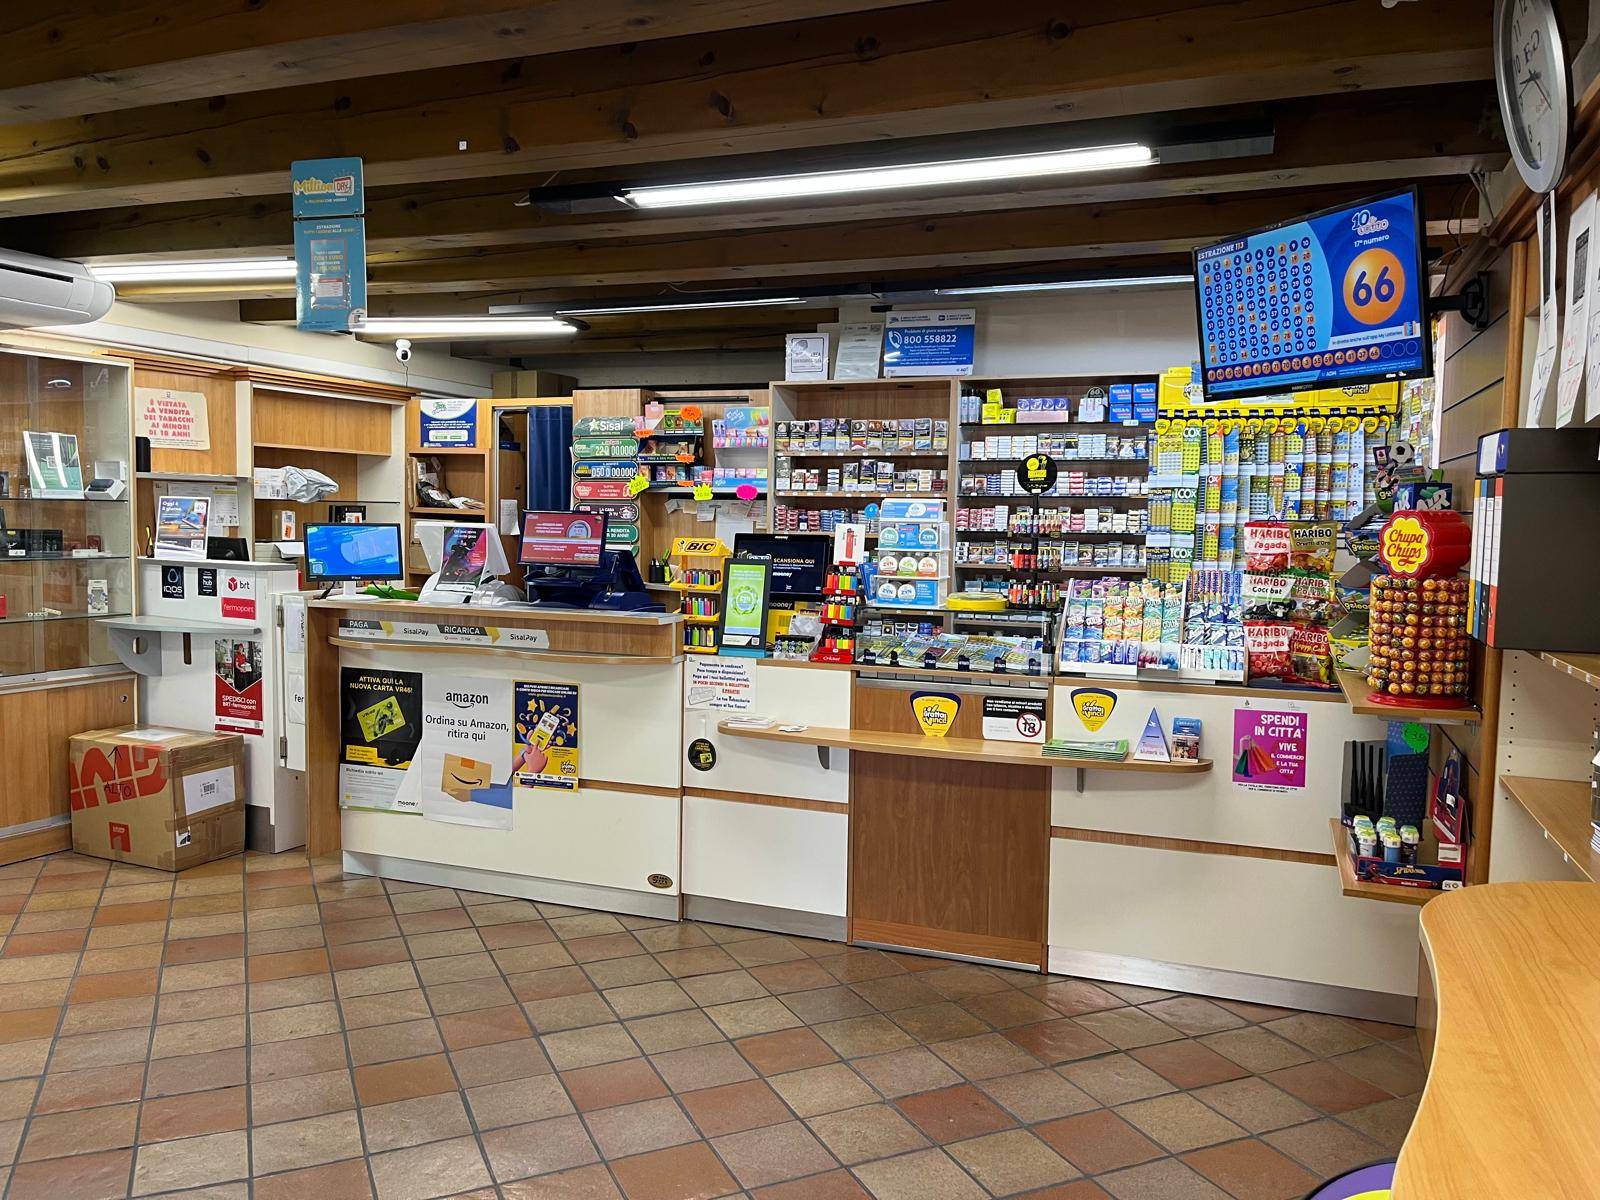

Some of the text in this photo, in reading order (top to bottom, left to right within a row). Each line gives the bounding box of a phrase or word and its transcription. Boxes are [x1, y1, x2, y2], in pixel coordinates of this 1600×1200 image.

[1364, 235, 1389, 245] numero
[1198, 242, 1244, 260] ESTRAZIONE 113
[1353, 266, 1395, 306] 66
[924, 335, 957, 343] 558822
[159, 415, 194, 423] TABACCHI
[600, 421, 624, 431] Sisal
[1294, 528, 1332, 539] HARIBO
[1390, 529, 1424, 546] Chupa
[687, 542, 715, 550] BIC
[1387, 543, 1422, 560] Chups
[240, 580, 250, 590] brt
[1250, 577, 1286, 586] HARIBO
[163, 585, 182, 594] IQOS
[224, 604, 254, 613] fermopoint
[404, 627, 429, 636] SisalPay
[444, 626, 480, 634] RICARICA
[510, 633, 537, 642] SisalPay
[1247, 628, 1287, 637] HARIBO
[1293, 632, 1328, 643] HARIBO
[1252, 640, 1284, 649] Tagada
[359, 676, 380, 684] ATTIVA
[222, 695, 245, 703] SPEDISCI
[446, 691, 489, 705] amazon
[923, 710, 947, 719] Gratta
[425, 715, 455, 726] Ordina
[470, 720, 509, 732] Amazon,
[1261, 714, 1299, 726] SPENDI
[1022, 722, 1036, 733] 18
[1255, 726, 1265, 736] IN
[448, 728, 486, 742] ritira qui
[1279, 742, 1297, 751] VIVE
[104, 782, 132, 797] ALTO
